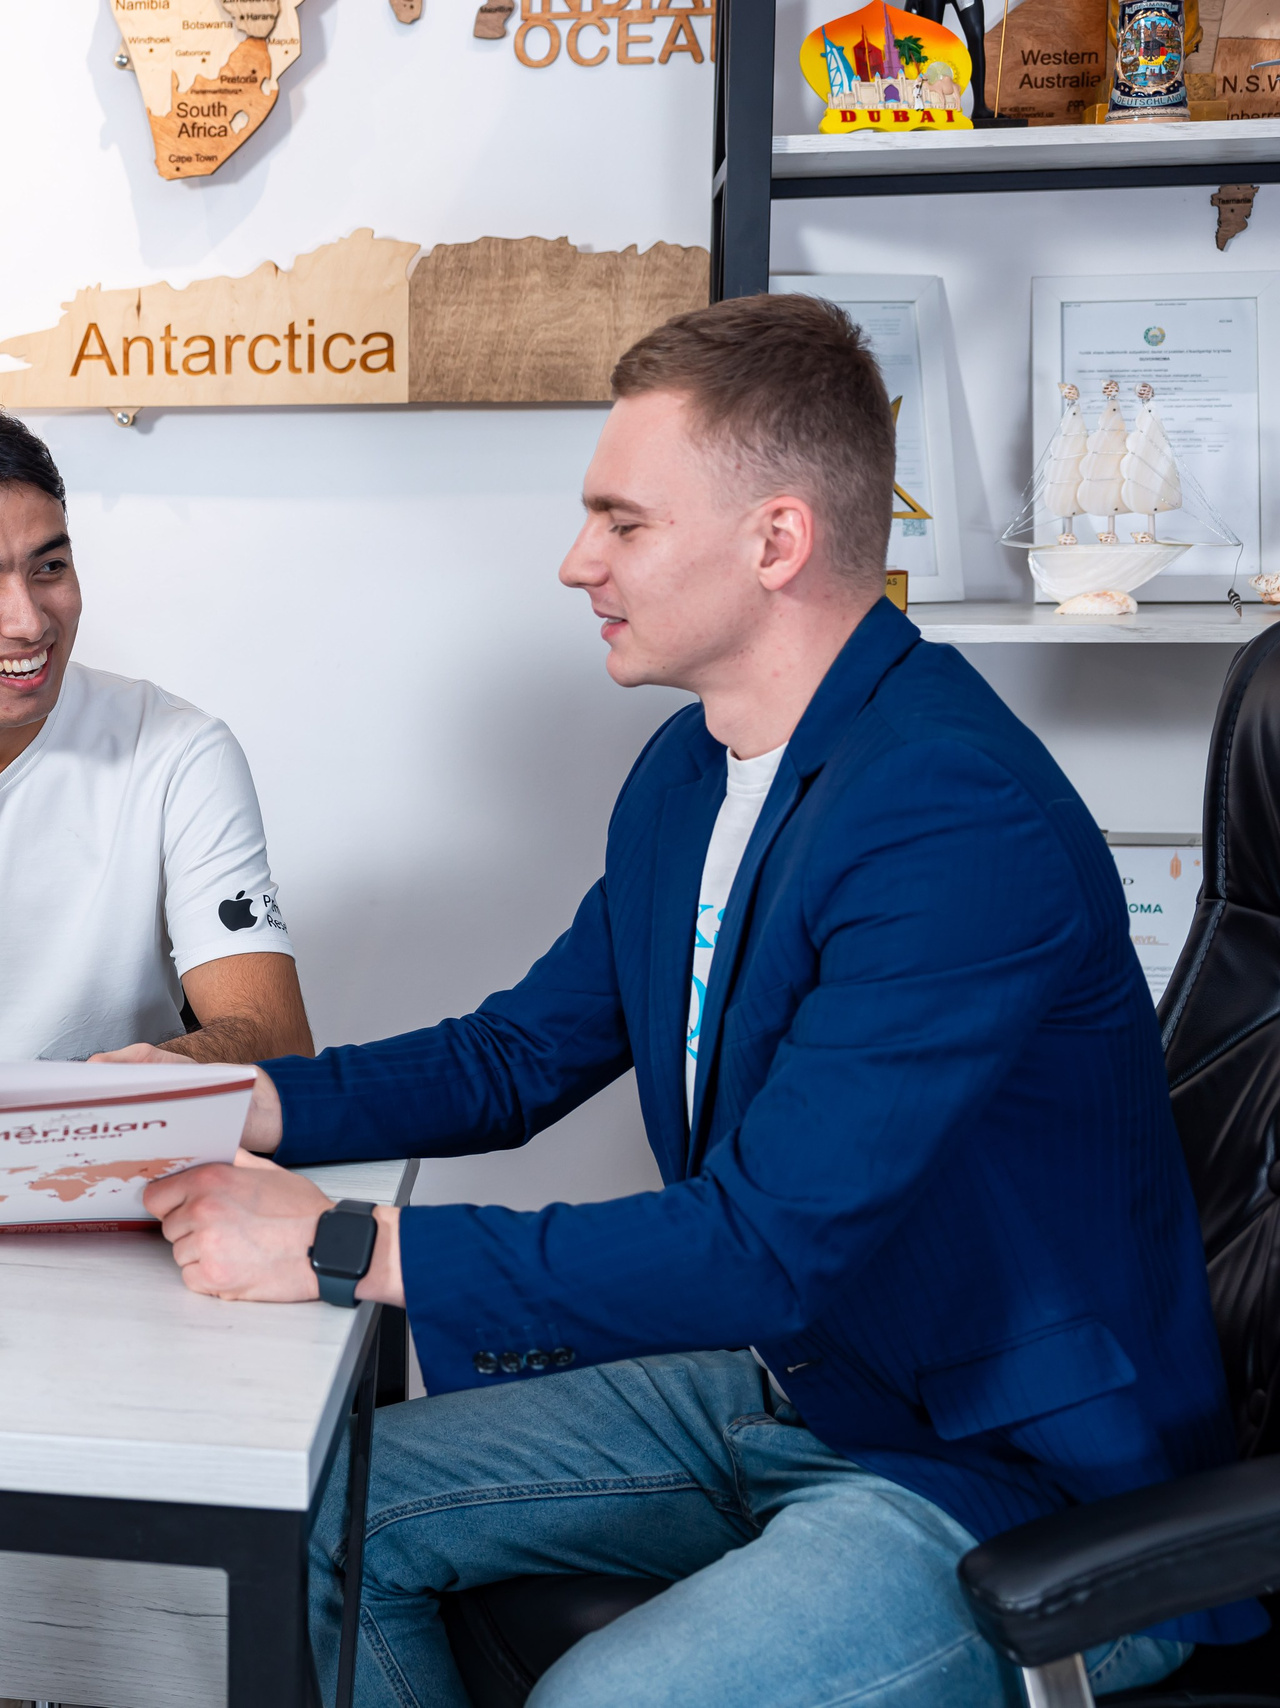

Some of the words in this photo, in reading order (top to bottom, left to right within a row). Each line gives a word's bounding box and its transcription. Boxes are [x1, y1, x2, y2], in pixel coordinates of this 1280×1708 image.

[182, 20, 233, 30] Botswana
[128, 36, 170, 44] Windhoek
[514, 14, 716, 68] OCEA
[1021, 49, 1098, 66] Western
[220, 74, 258, 84] Pretoria
[1018, 72, 1101, 89] Australia
[1116, 93, 1182, 106] DEUTSCHLAND
[176, 102, 228, 118] South
[841, 110, 955, 123] DUBAI
[177, 122, 228, 138] Africa
[168, 154, 192, 164] Cape
[196, 154, 218, 163] Town
[70, 319, 396, 377] Antarctica
